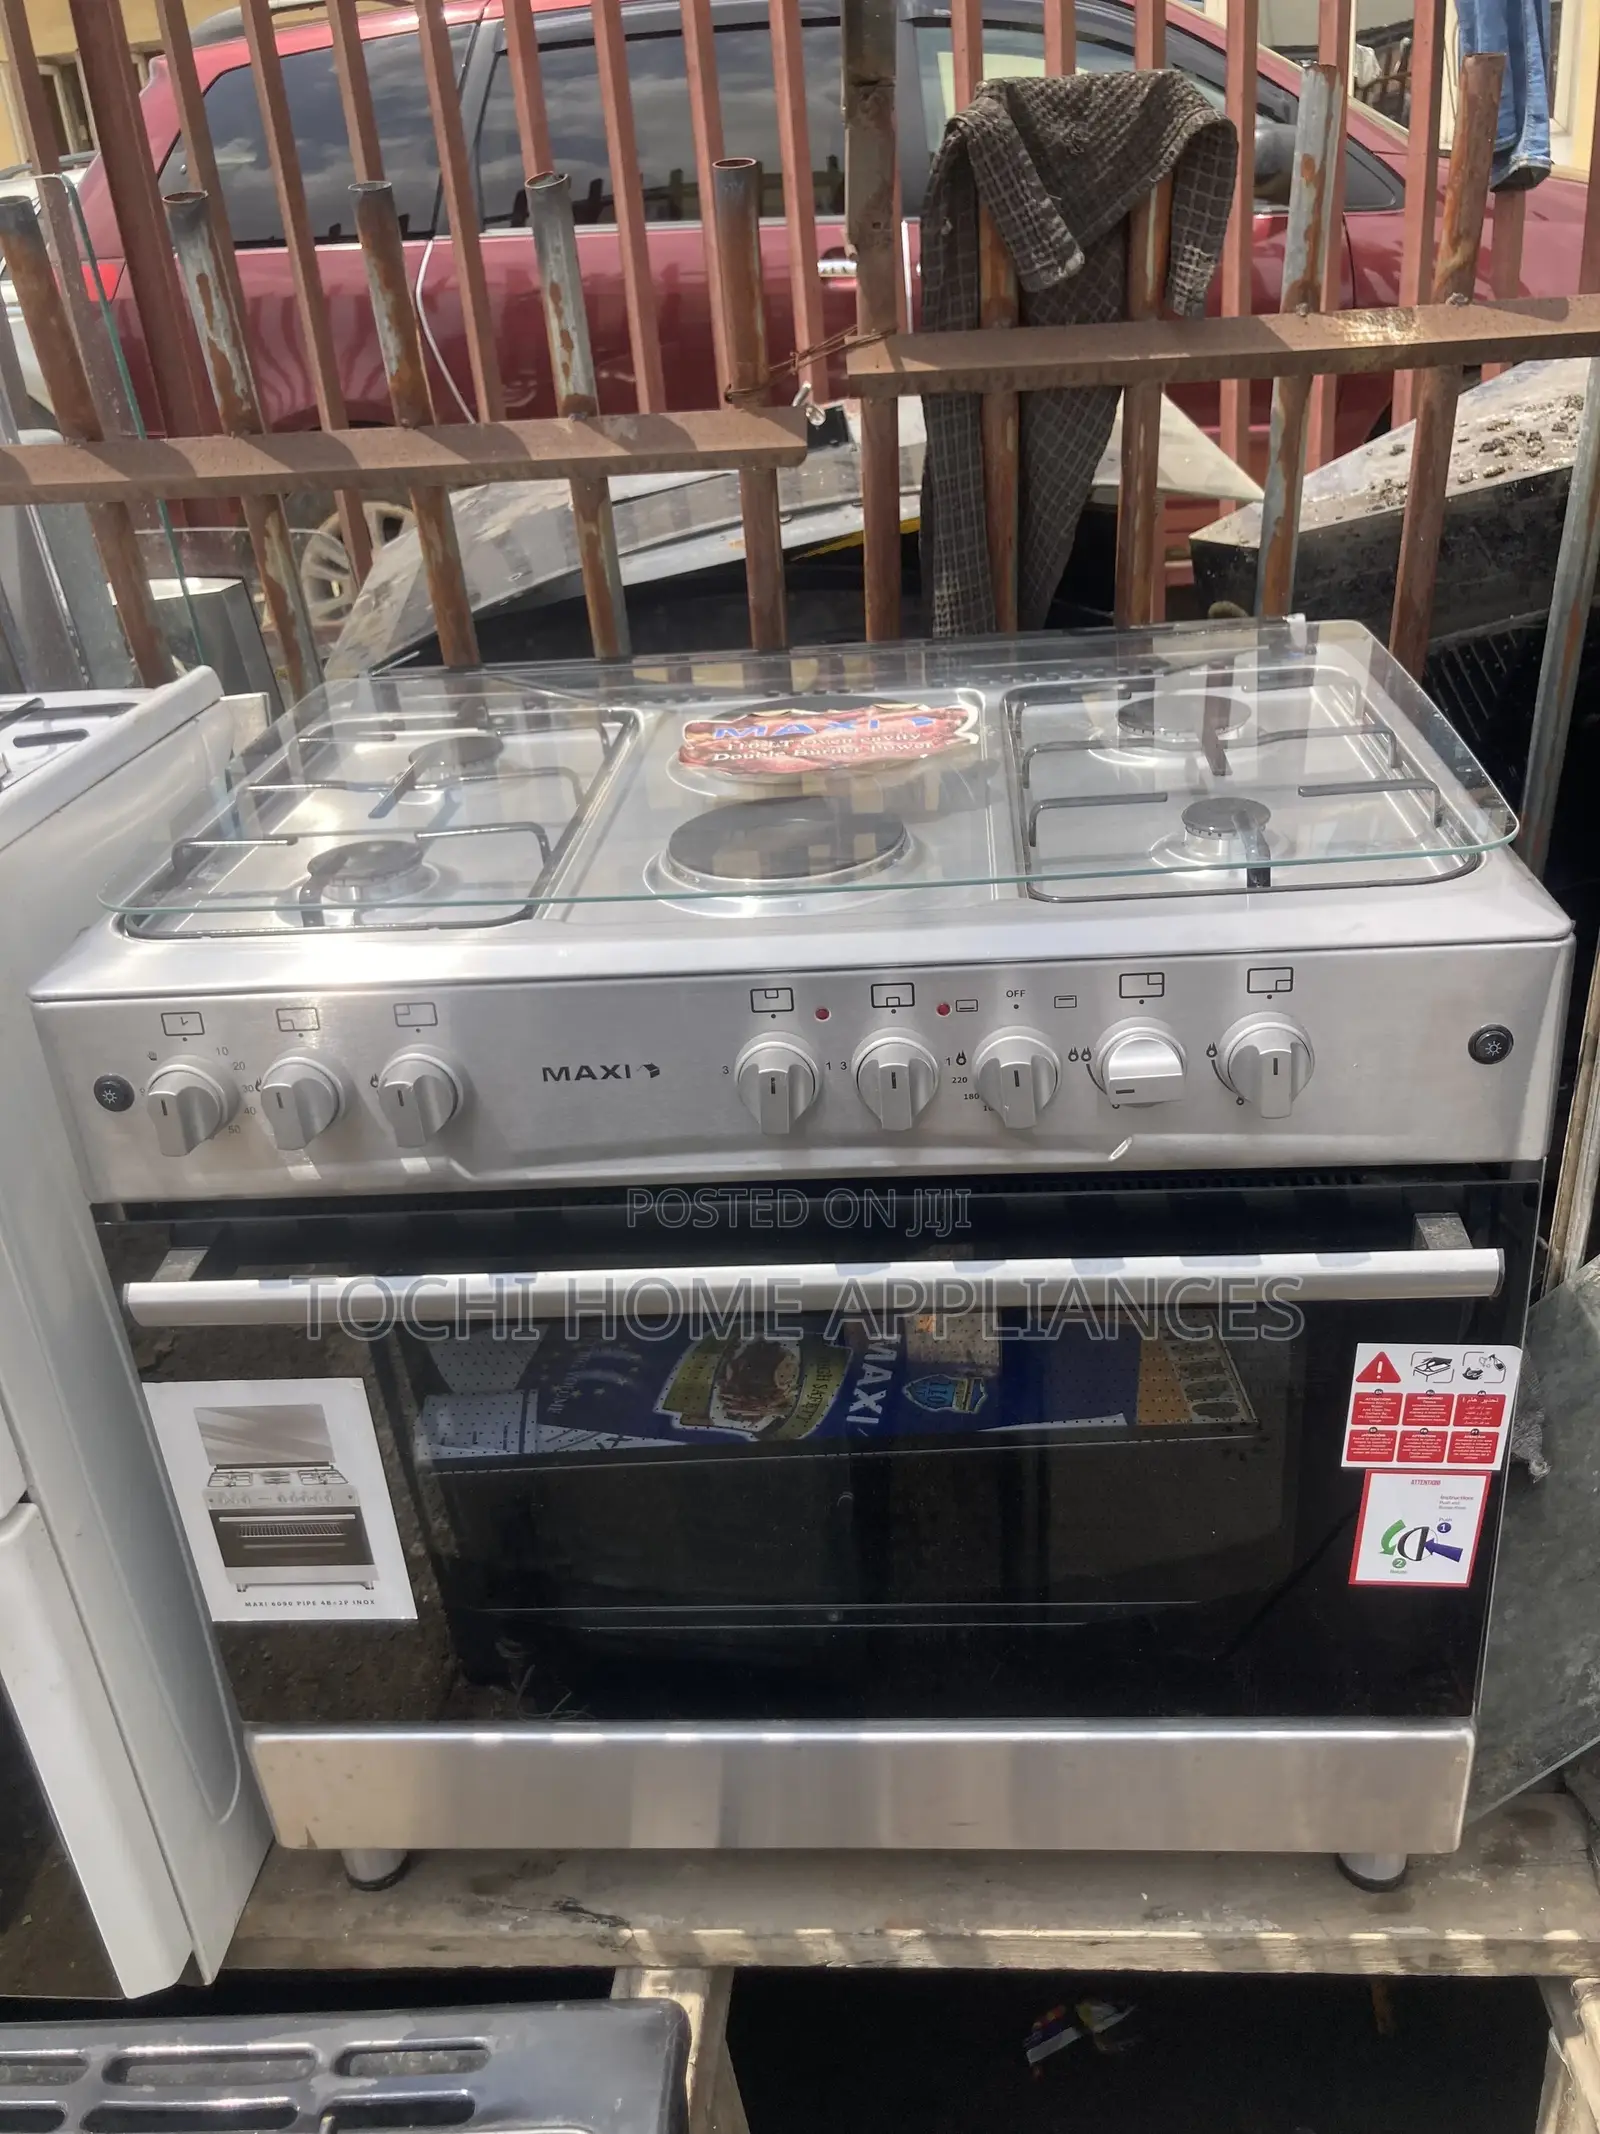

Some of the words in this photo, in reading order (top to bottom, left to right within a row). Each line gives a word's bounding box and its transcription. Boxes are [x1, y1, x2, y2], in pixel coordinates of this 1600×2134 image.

[713, 718, 881, 739] MAXI
[711, 750, 786, 762] Double
[794, 745, 861, 757] Burner
[1005, 989, 1026, 998] OFF
[215, 1046, 229, 1056] 10
[233, 1061, 246, 1071] 20
[825, 1061, 832, 1071] 1
[840, 1061, 848, 1071] 3
[945, 1057, 951, 1066] 1
[541, 1063, 632, 1082] MAXI
[722, 1065, 730, 1075] 3
[952, 1076, 968, 1084] 220
[242, 1084, 254, 1093] 30
[244, 1106, 256, 1116] 40
[228, 1124, 241, 1134] 50
[846, 1335, 901, 1424] MAXI
[796, 1383, 828, 1424] SAFETY
[1441, 1524, 1447, 1532] 1
[1395, 1559, 1403, 1567] 2
